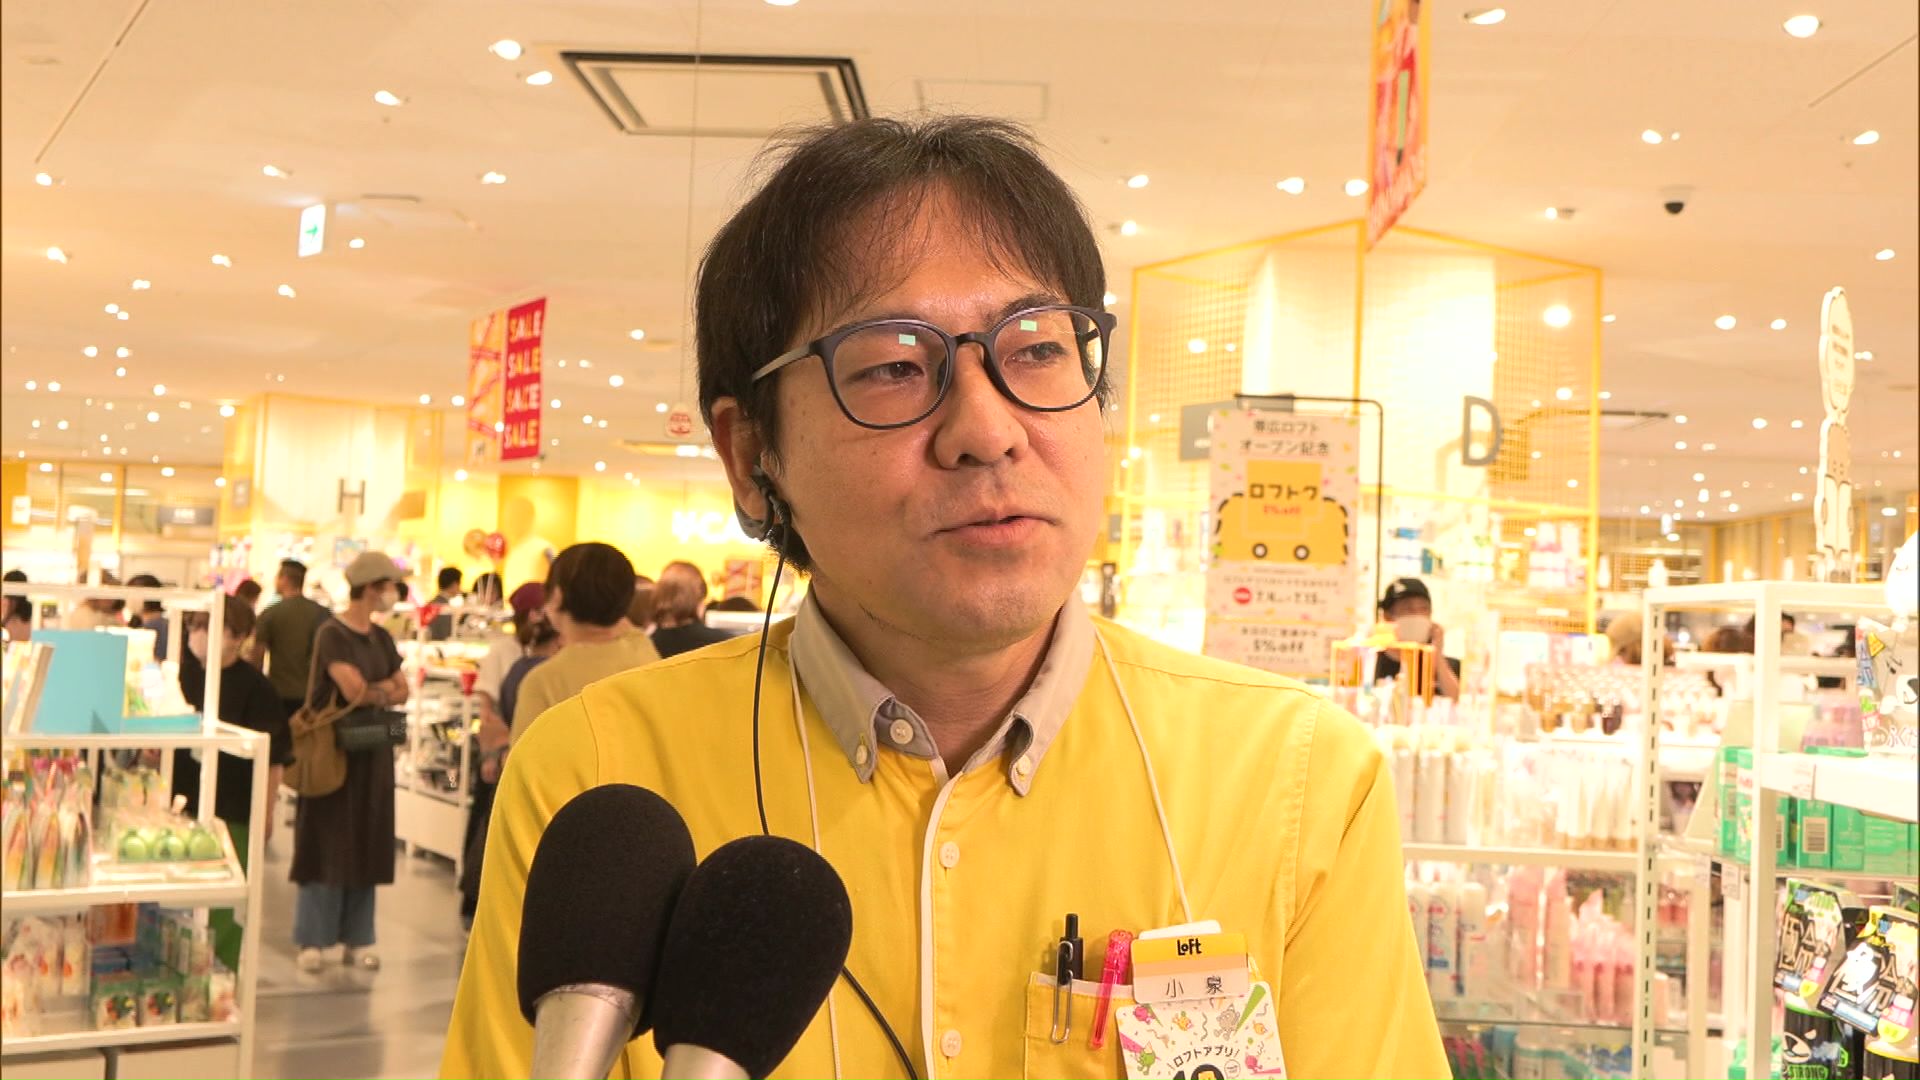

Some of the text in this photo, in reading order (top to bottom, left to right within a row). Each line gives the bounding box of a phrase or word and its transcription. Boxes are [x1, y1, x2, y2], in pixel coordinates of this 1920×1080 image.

[509, 310, 542, 343] SALE
[508, 347, 540, 378] SALE
[507, 383, 539, 413] SALE
[504, 419, 537, 449] SALE
[1462, 395, 1501, 467] D
[1240, 440, 1330, 456] オープン記念
[339, 479, 365, 514] H
